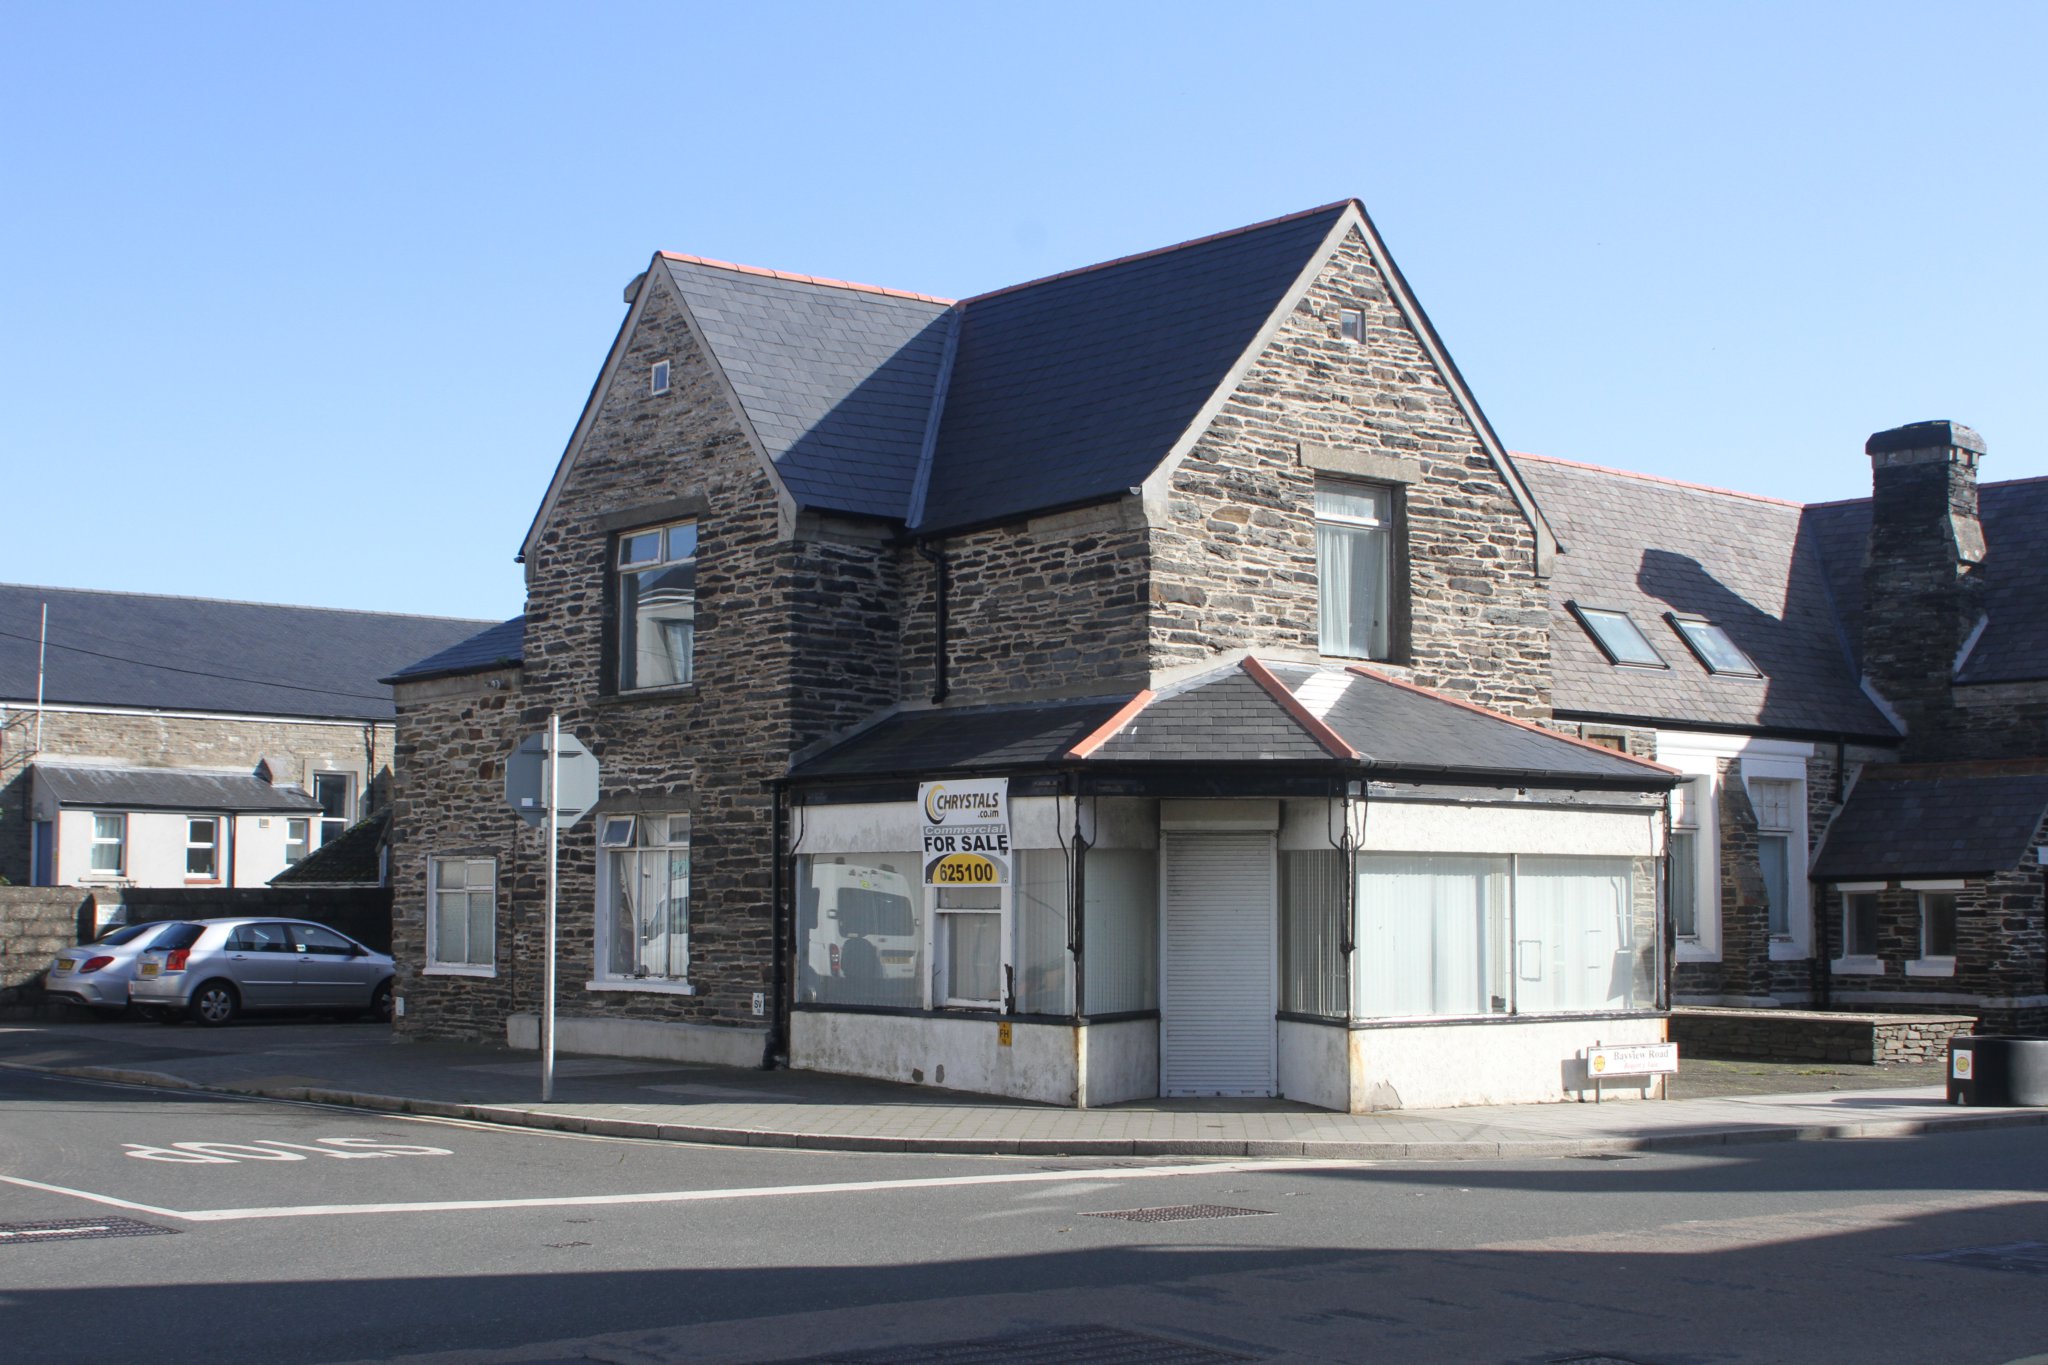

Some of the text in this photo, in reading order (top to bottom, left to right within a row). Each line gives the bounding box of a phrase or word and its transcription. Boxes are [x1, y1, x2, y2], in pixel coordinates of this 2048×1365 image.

[937, 792, 999, 810] CHRYSTALS
[977, 809, 999, 819] .co.im
[925, 824, 1004, 835] Commercial
[924, 835, 1009, 852] FOR SALE
[940, 863, 993, 882] 625100
[1614, 1049, 1669, 1062] Bayview Road
[120, 1137, 454, 1163] STOP
